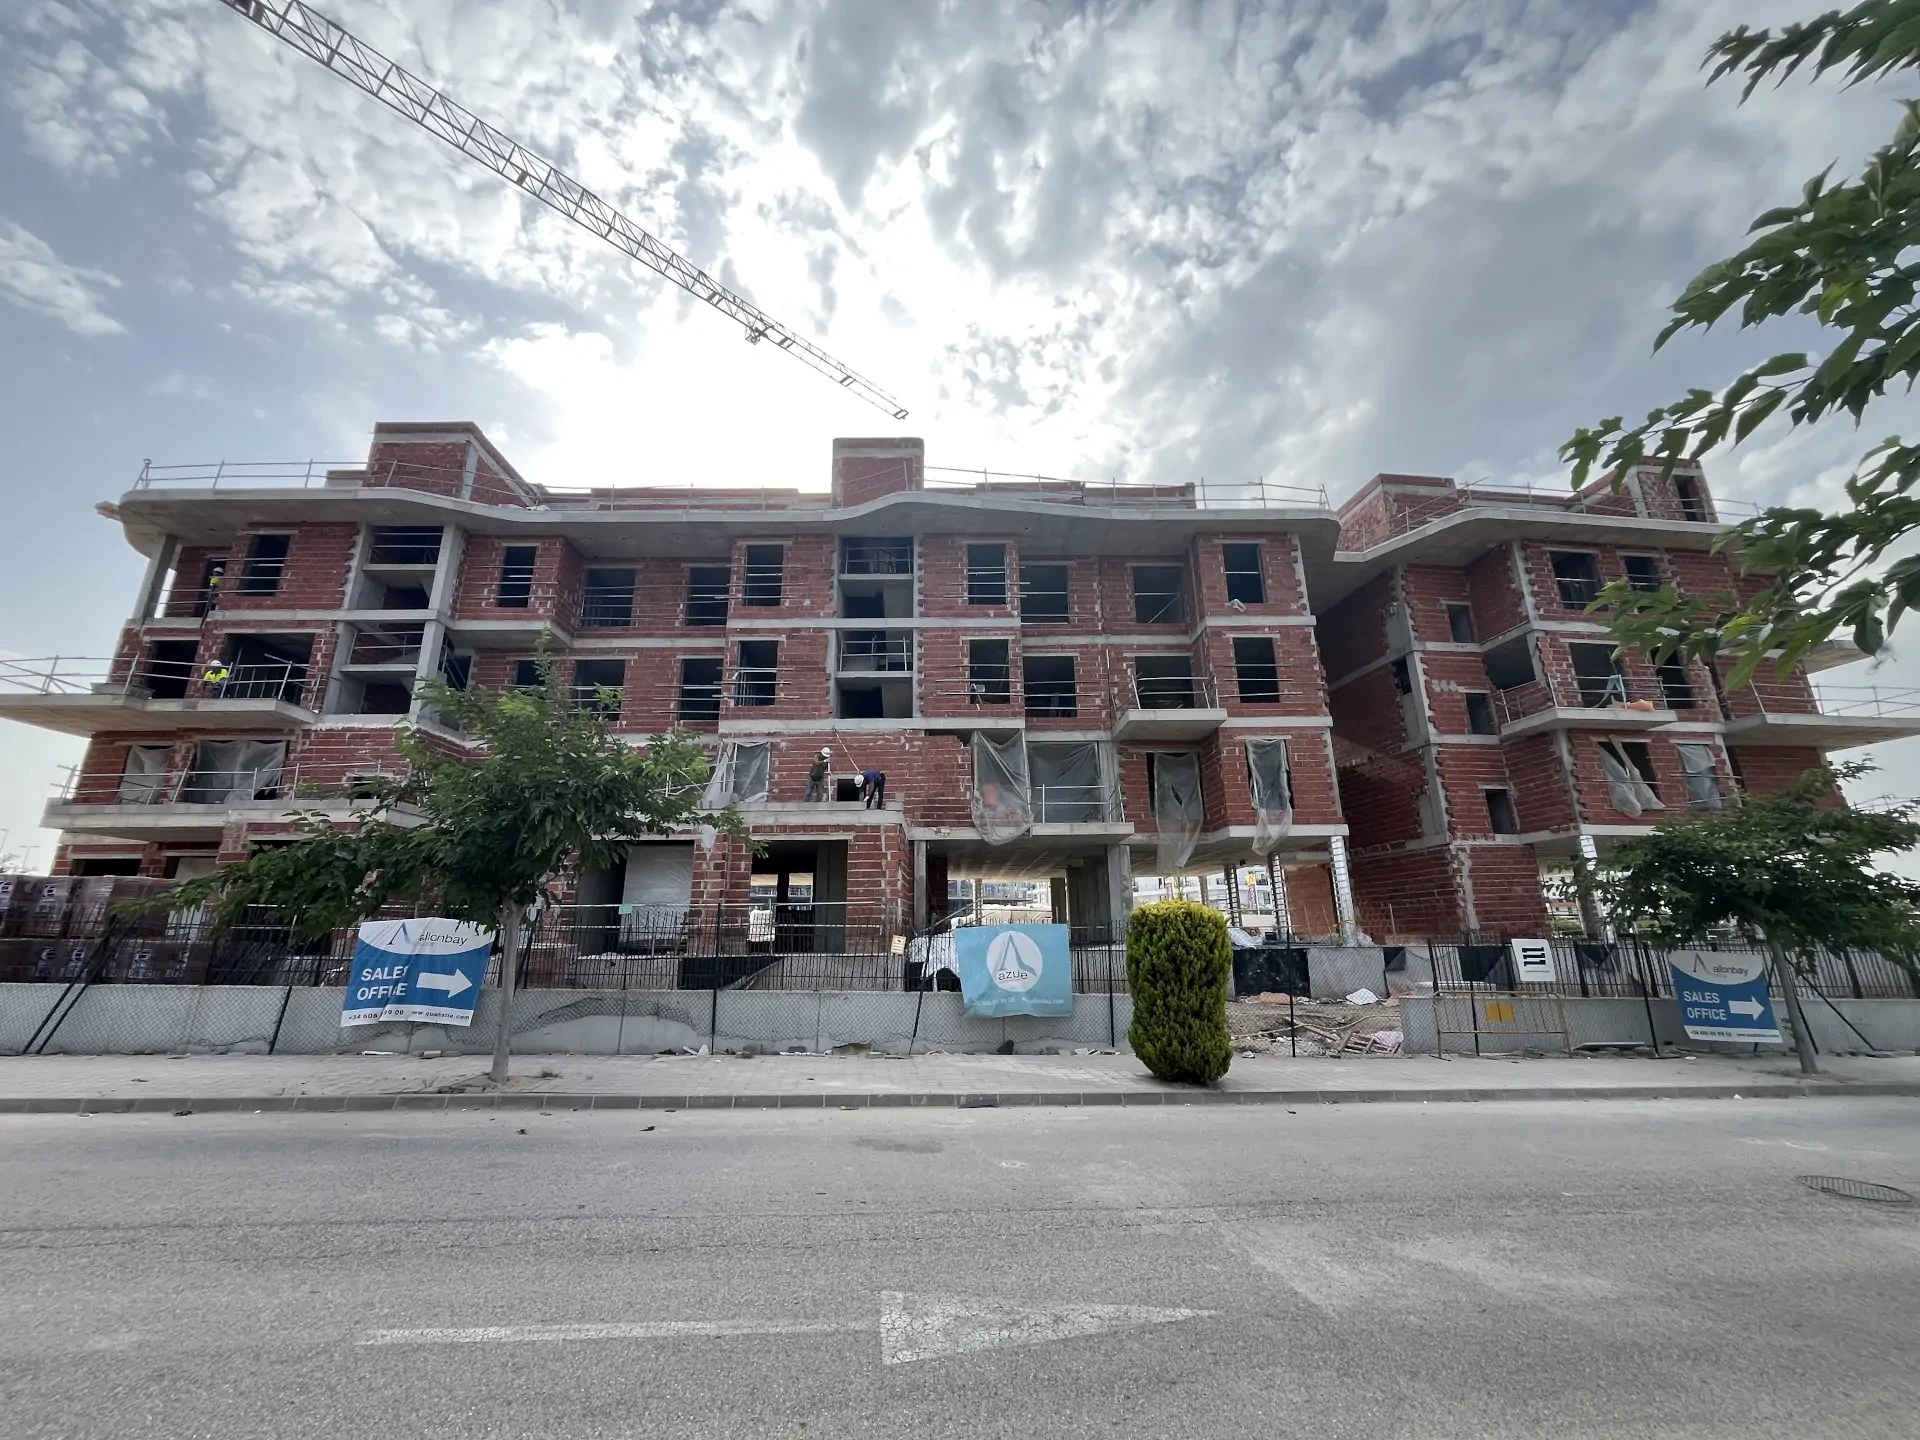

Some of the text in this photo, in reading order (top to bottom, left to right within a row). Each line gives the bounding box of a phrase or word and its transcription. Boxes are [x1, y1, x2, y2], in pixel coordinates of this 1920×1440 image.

[998, 970, 1028, 981] azue
[356, 982, 408, 1001] OFFIE
[1682, 990, 1720, 1004] SALES
[1686, 1007, 1727, 1020] OFFICE
